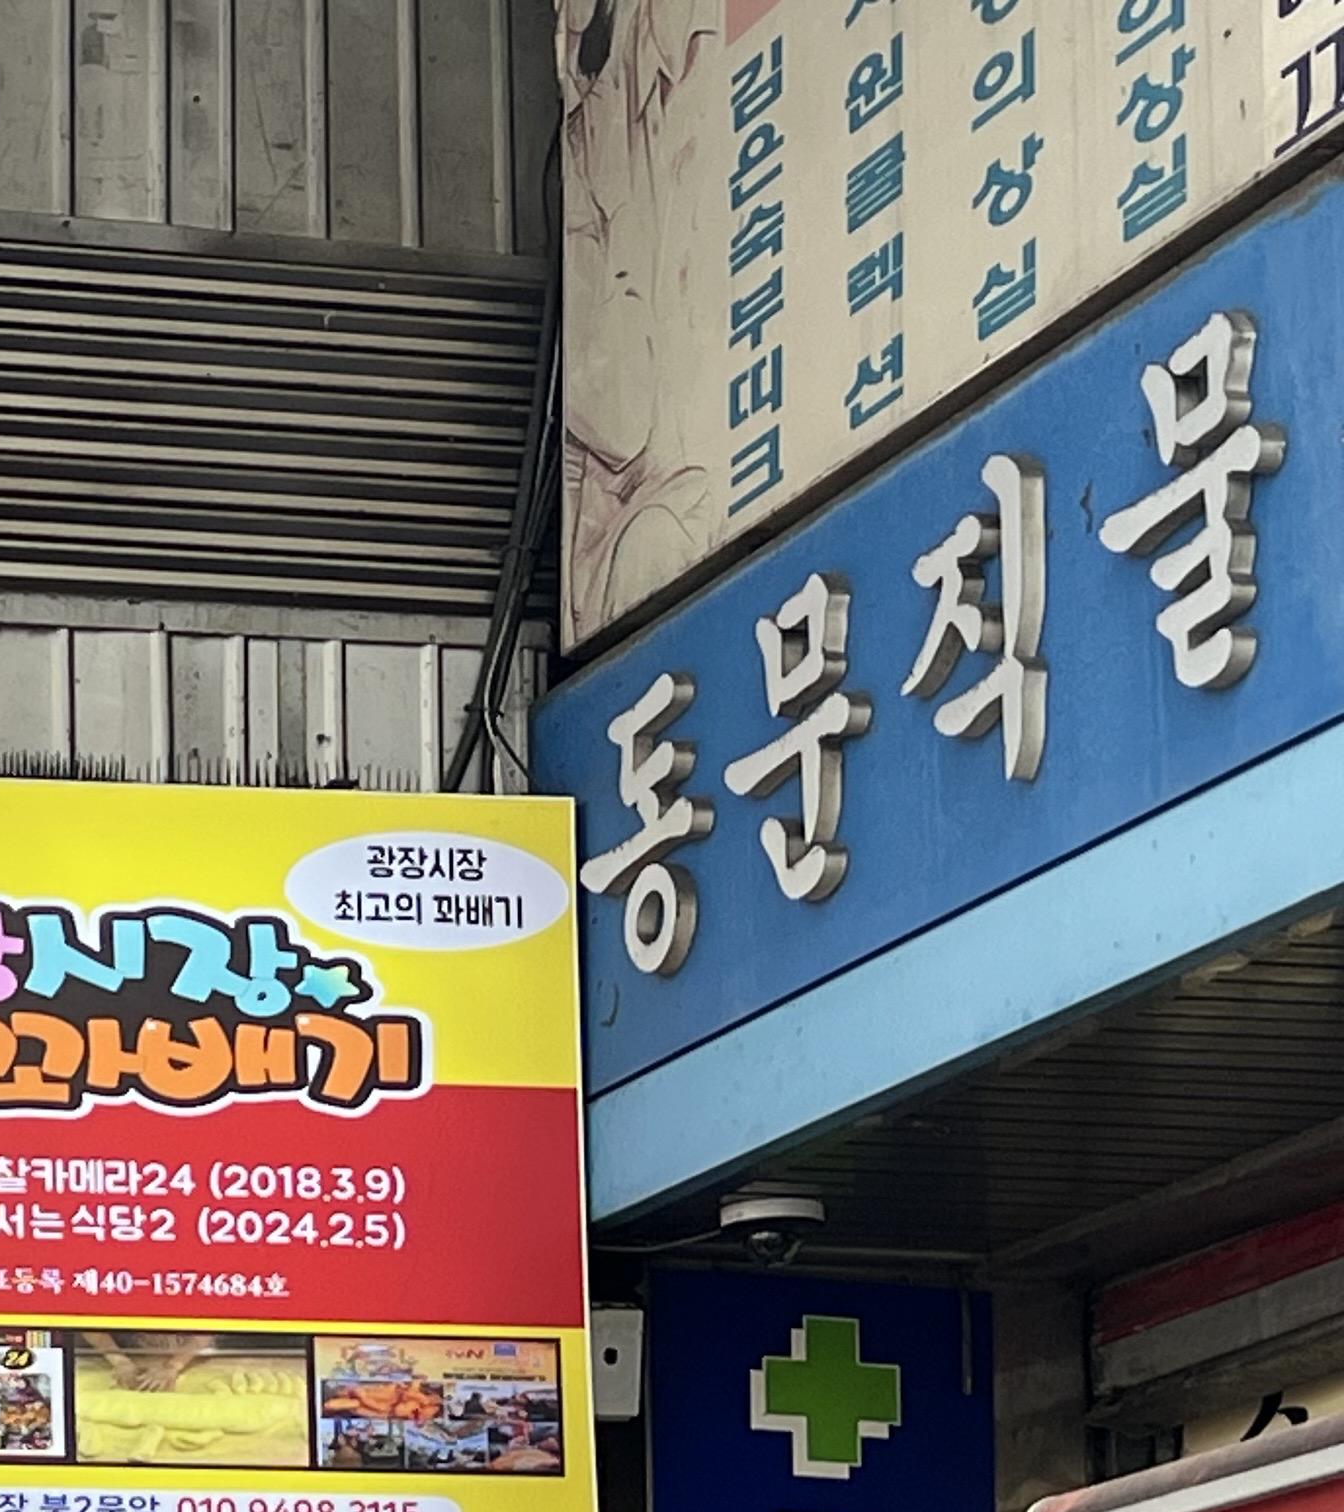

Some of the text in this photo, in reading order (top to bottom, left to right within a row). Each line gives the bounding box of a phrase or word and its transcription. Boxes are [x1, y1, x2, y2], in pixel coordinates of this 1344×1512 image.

[580, 310, 1292, 975] 동문직물
[365, 845, 486, 883] 광장시장
[332, 889, 526, 932] 최고의 꽈배기
[210, 1162, 407, 1204] (2018.3.9)
[198, 1209, 407, 1250] (2024.2.5)
